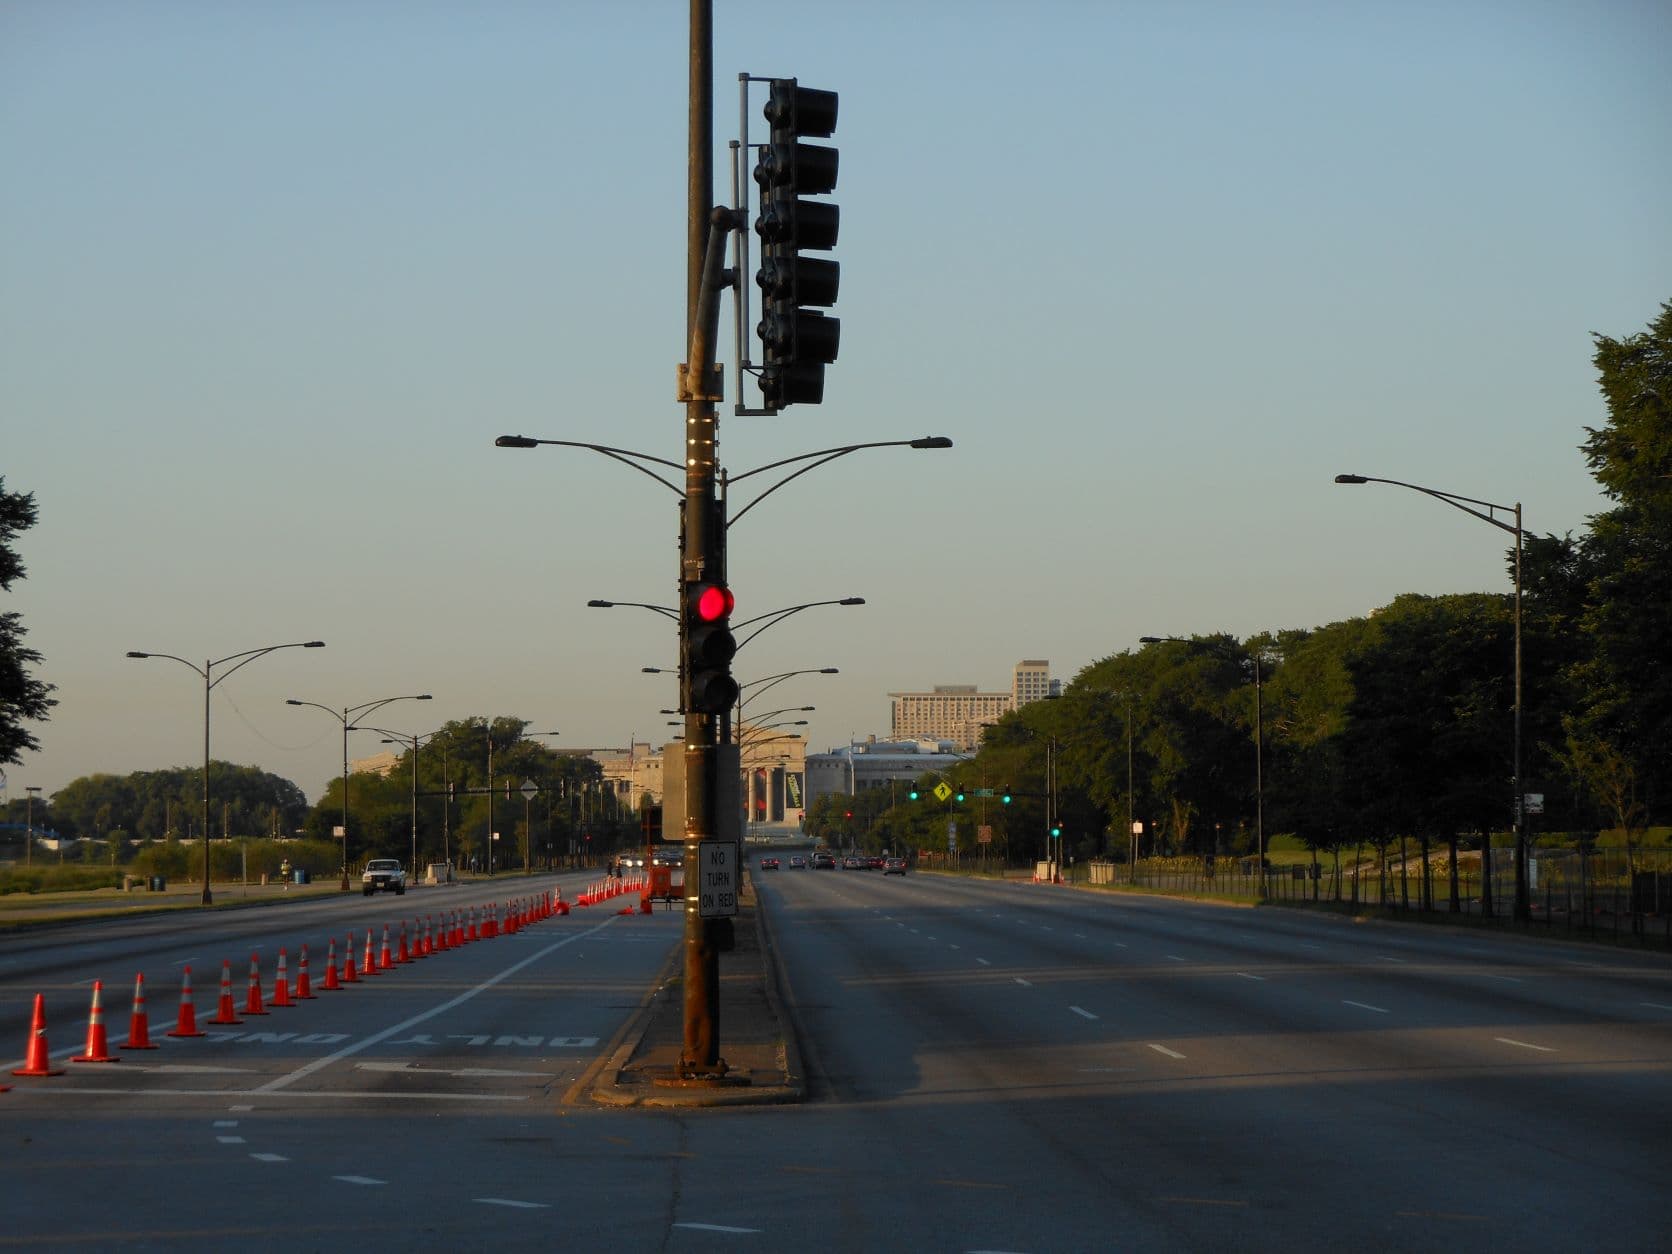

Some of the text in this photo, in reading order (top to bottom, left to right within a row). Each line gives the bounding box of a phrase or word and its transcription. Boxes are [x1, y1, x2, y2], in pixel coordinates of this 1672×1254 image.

[711, 852, 725, 864] NO
[707, 872, 729, 886] TURN
[702, 893, 734, 908] ON RED
[384, 1036, 600, 1046] ONLY
